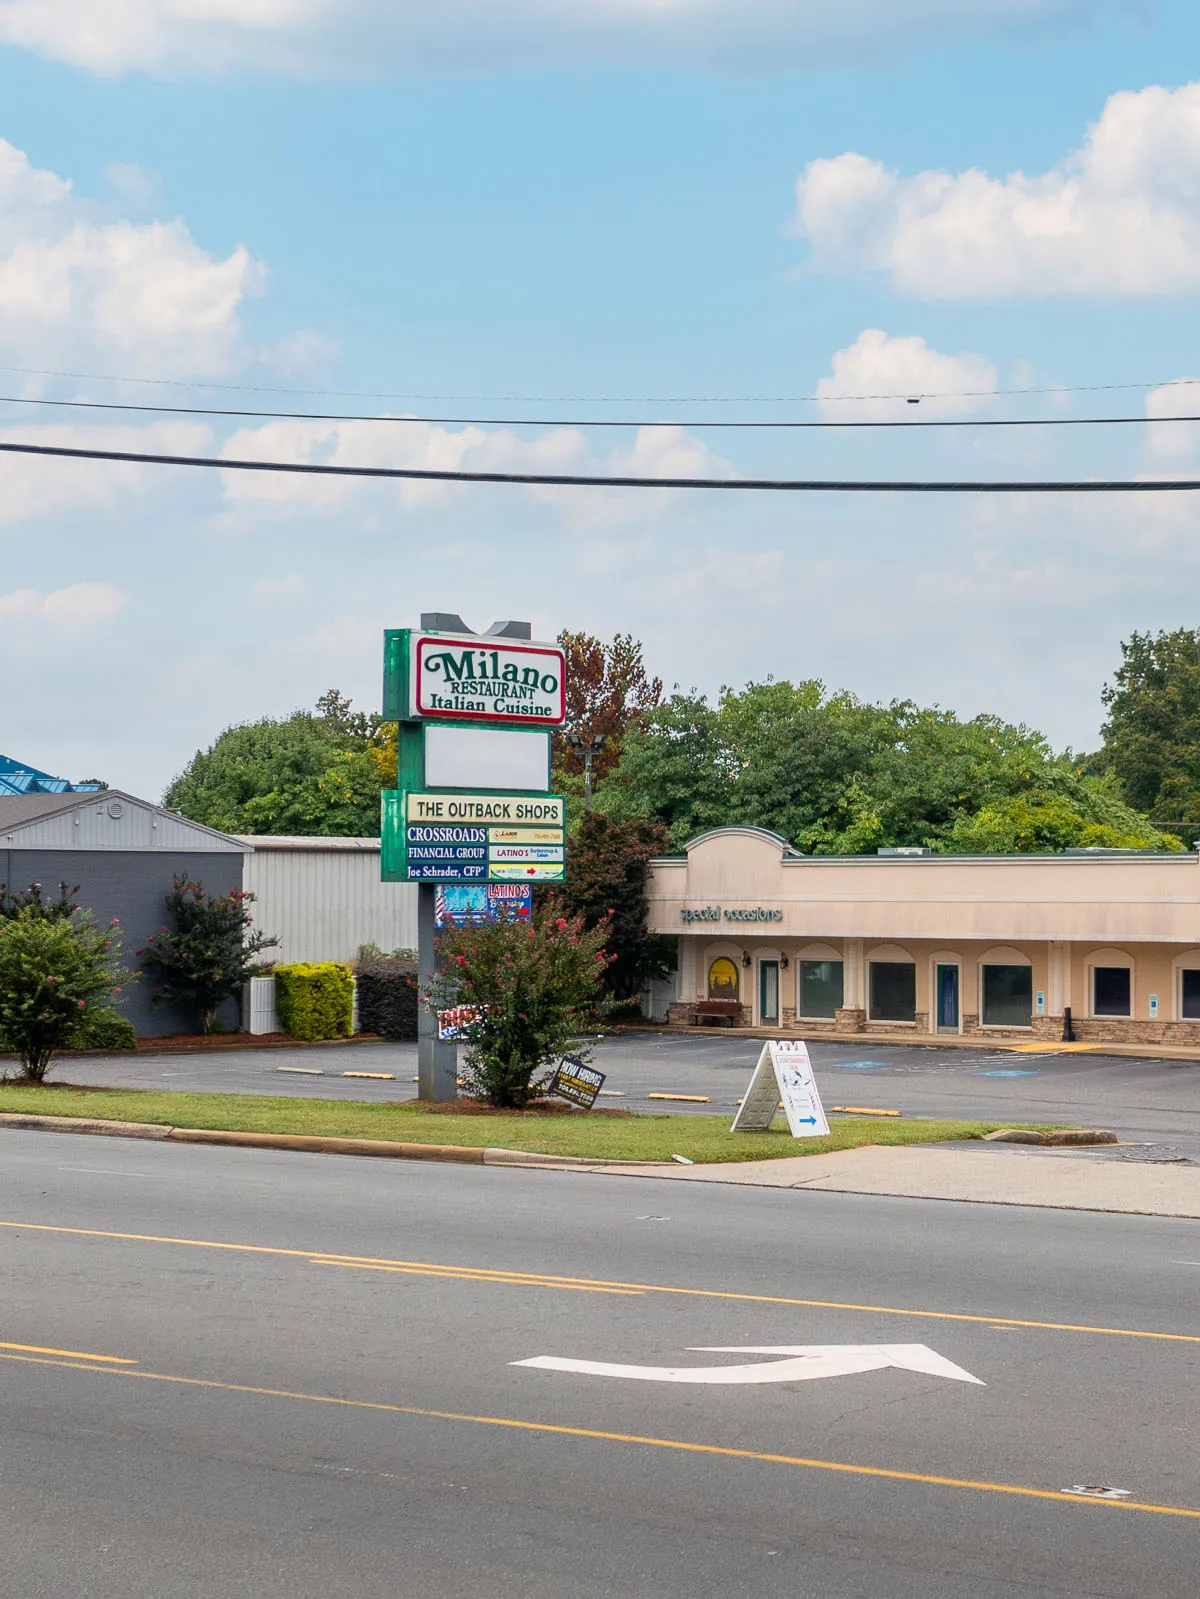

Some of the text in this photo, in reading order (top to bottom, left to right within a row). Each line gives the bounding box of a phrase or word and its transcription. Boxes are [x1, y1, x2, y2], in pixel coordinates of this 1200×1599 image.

[424, 651, 558, 694] Milano
[450, 681, 536, 700] RESTAURANT
[430, 694, 552, 716] Italian Cuisine
[418, 802, 559, 820] THE OUTBACK SHOPS
[407, 827, 486, 842] CROSSROADS
[408, 847, 485, 859] FINANCIAL GROUP
[497, 849, 529, 857] LATINO'S
[407, 866, 421, 879] Joe
[422, 866, 461, 878] Schrader,
[488, 884, 530, 898] LATINO'S
[681, 905, 783, 926] special occasions
[560, 1060, 602, 1087] NOW HIRING
